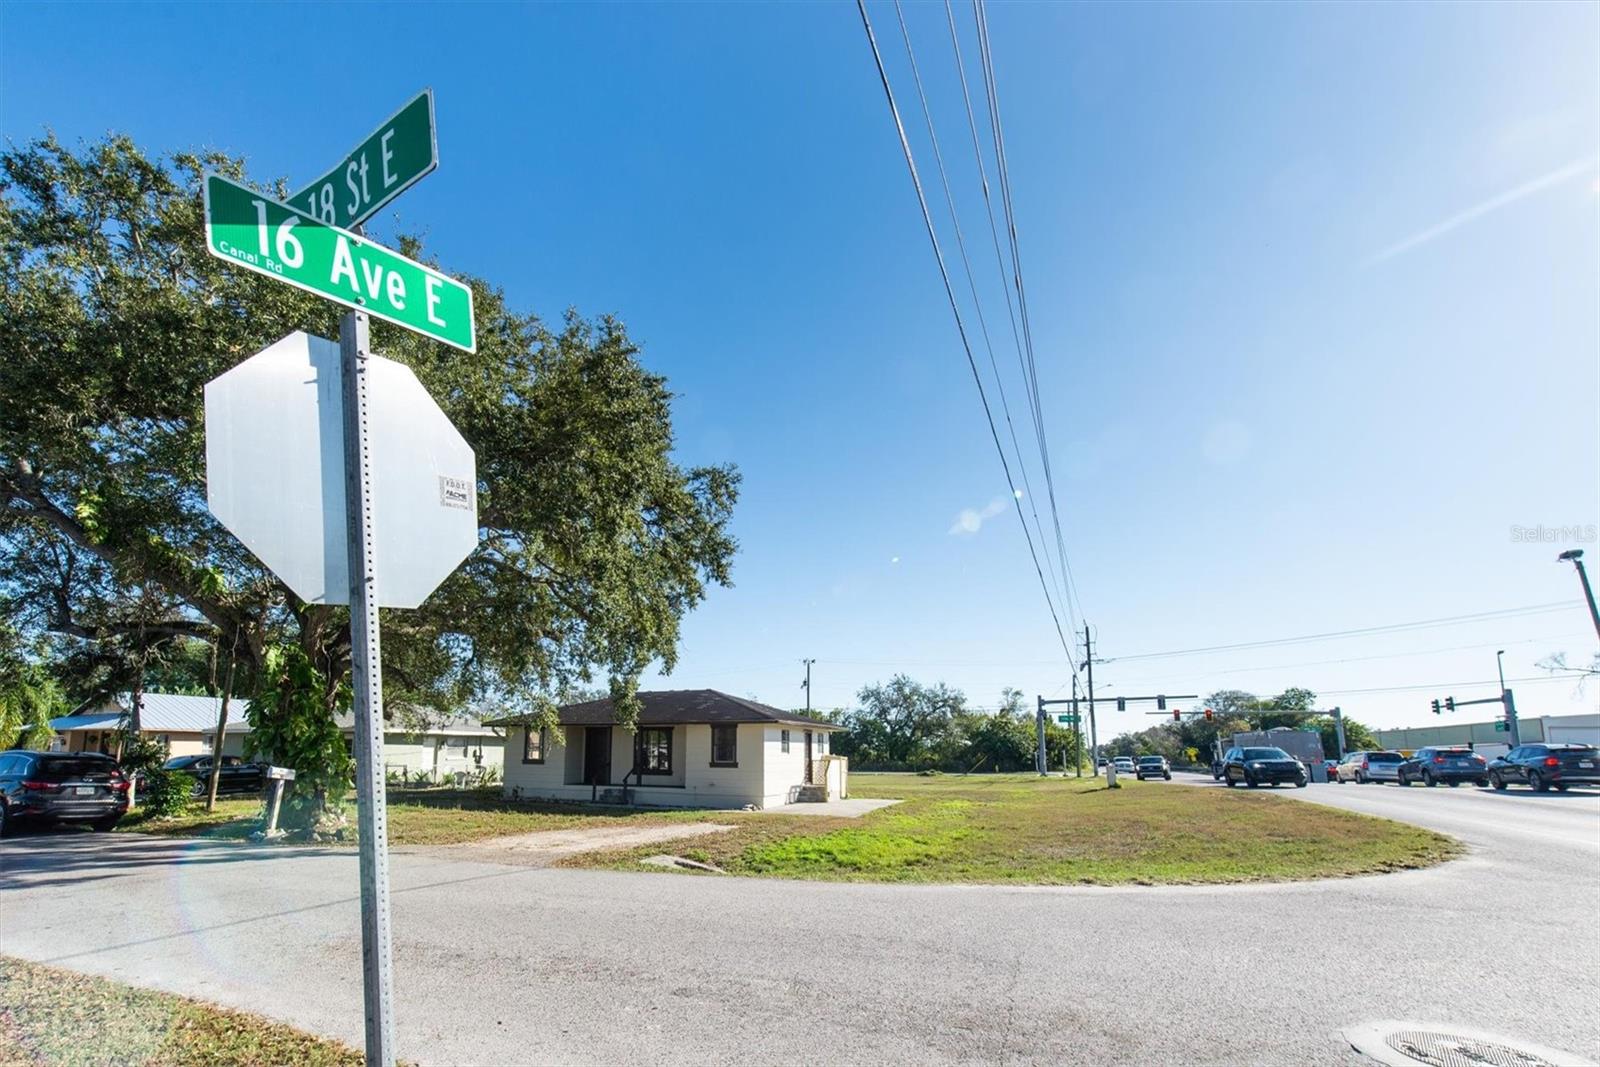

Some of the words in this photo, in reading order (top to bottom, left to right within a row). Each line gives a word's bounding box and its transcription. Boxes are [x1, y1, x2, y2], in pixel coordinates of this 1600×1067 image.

[307, 182, 335, 226] 18
[346, 151, 372, 216] St
[381, 128, 398, 189] E
[219, 240, 258, 266] Canal
[266, 259, 283, 274] Rd
[251, 199, 304, 269] 16
[330, 234, 406, 310] Ave
[424, 274, 446, 328] E
